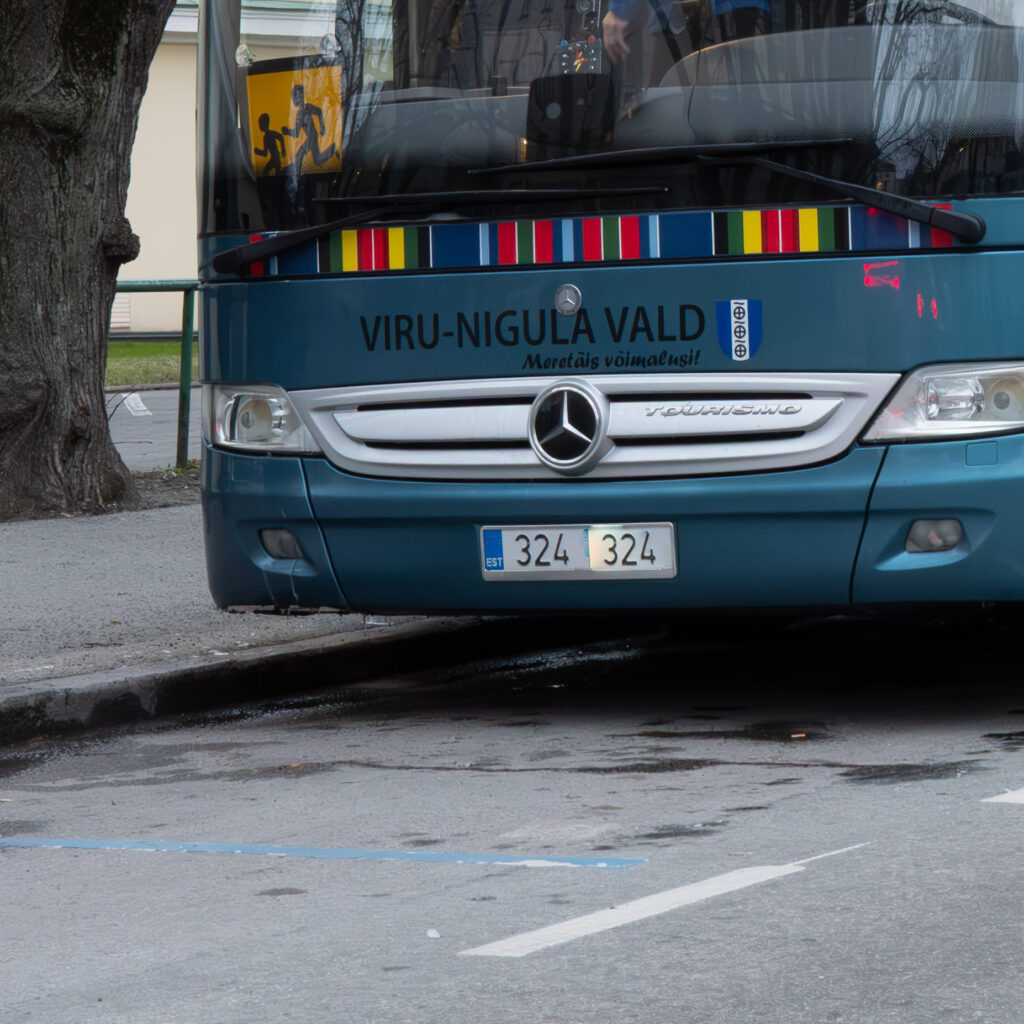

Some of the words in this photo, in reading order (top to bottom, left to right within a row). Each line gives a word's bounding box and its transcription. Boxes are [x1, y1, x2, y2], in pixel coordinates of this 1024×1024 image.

[360, 307, 596, 352] VIRU-NIGULA
[603, 304, 706, 343] VALD
[521, 351, 599, 370] Meretäis
[605, 349, 701, 369] võimalusi!
[645, 402, 802, 417] TOURISMO
[515, 533, 569, 567] 324
[602, 531, 656, 566] 324
[486, 557, 503, 568] EST
